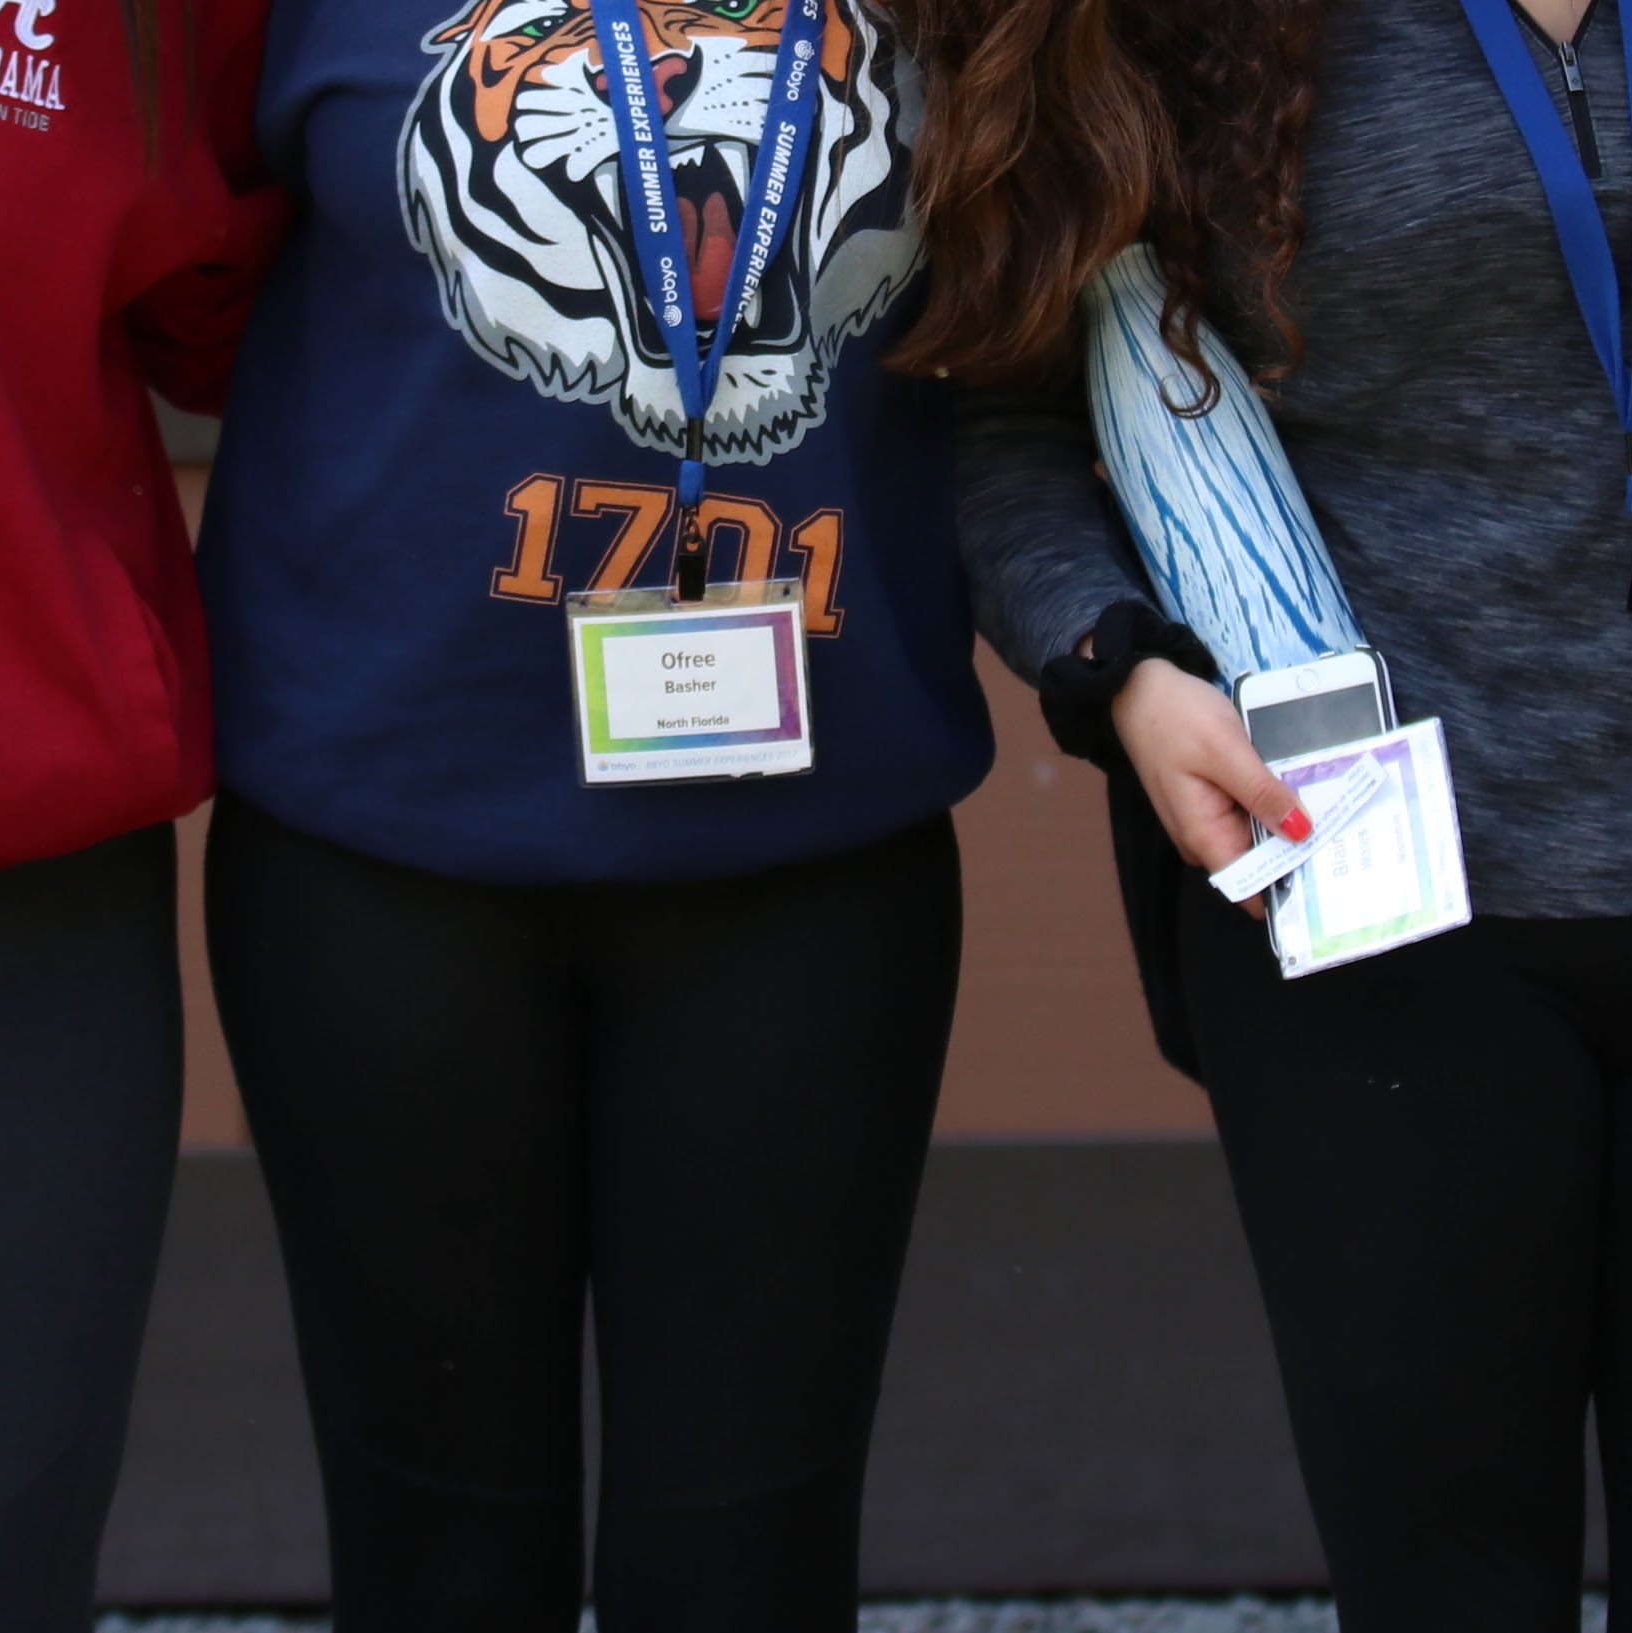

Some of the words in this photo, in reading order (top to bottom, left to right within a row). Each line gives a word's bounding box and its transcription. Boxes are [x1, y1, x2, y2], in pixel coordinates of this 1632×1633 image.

[615, 21, 654, 144] EXPERIENCES
[787, 60, 808, 101] bbyo
[14, 107, 49, 132] TIDE
[764, 120, 797, 204] SUMMER
[633, 149, 667, 234] SUMMER
[660, 257, 677, 303] bbyo
[489, 472, 845, 638] 1701
[661, 652, 716, 671] Ofree
[665, 679, 717, 695] Basher
[657, 717, 689, 730] North
[691, 714, 730, 728] Florida
